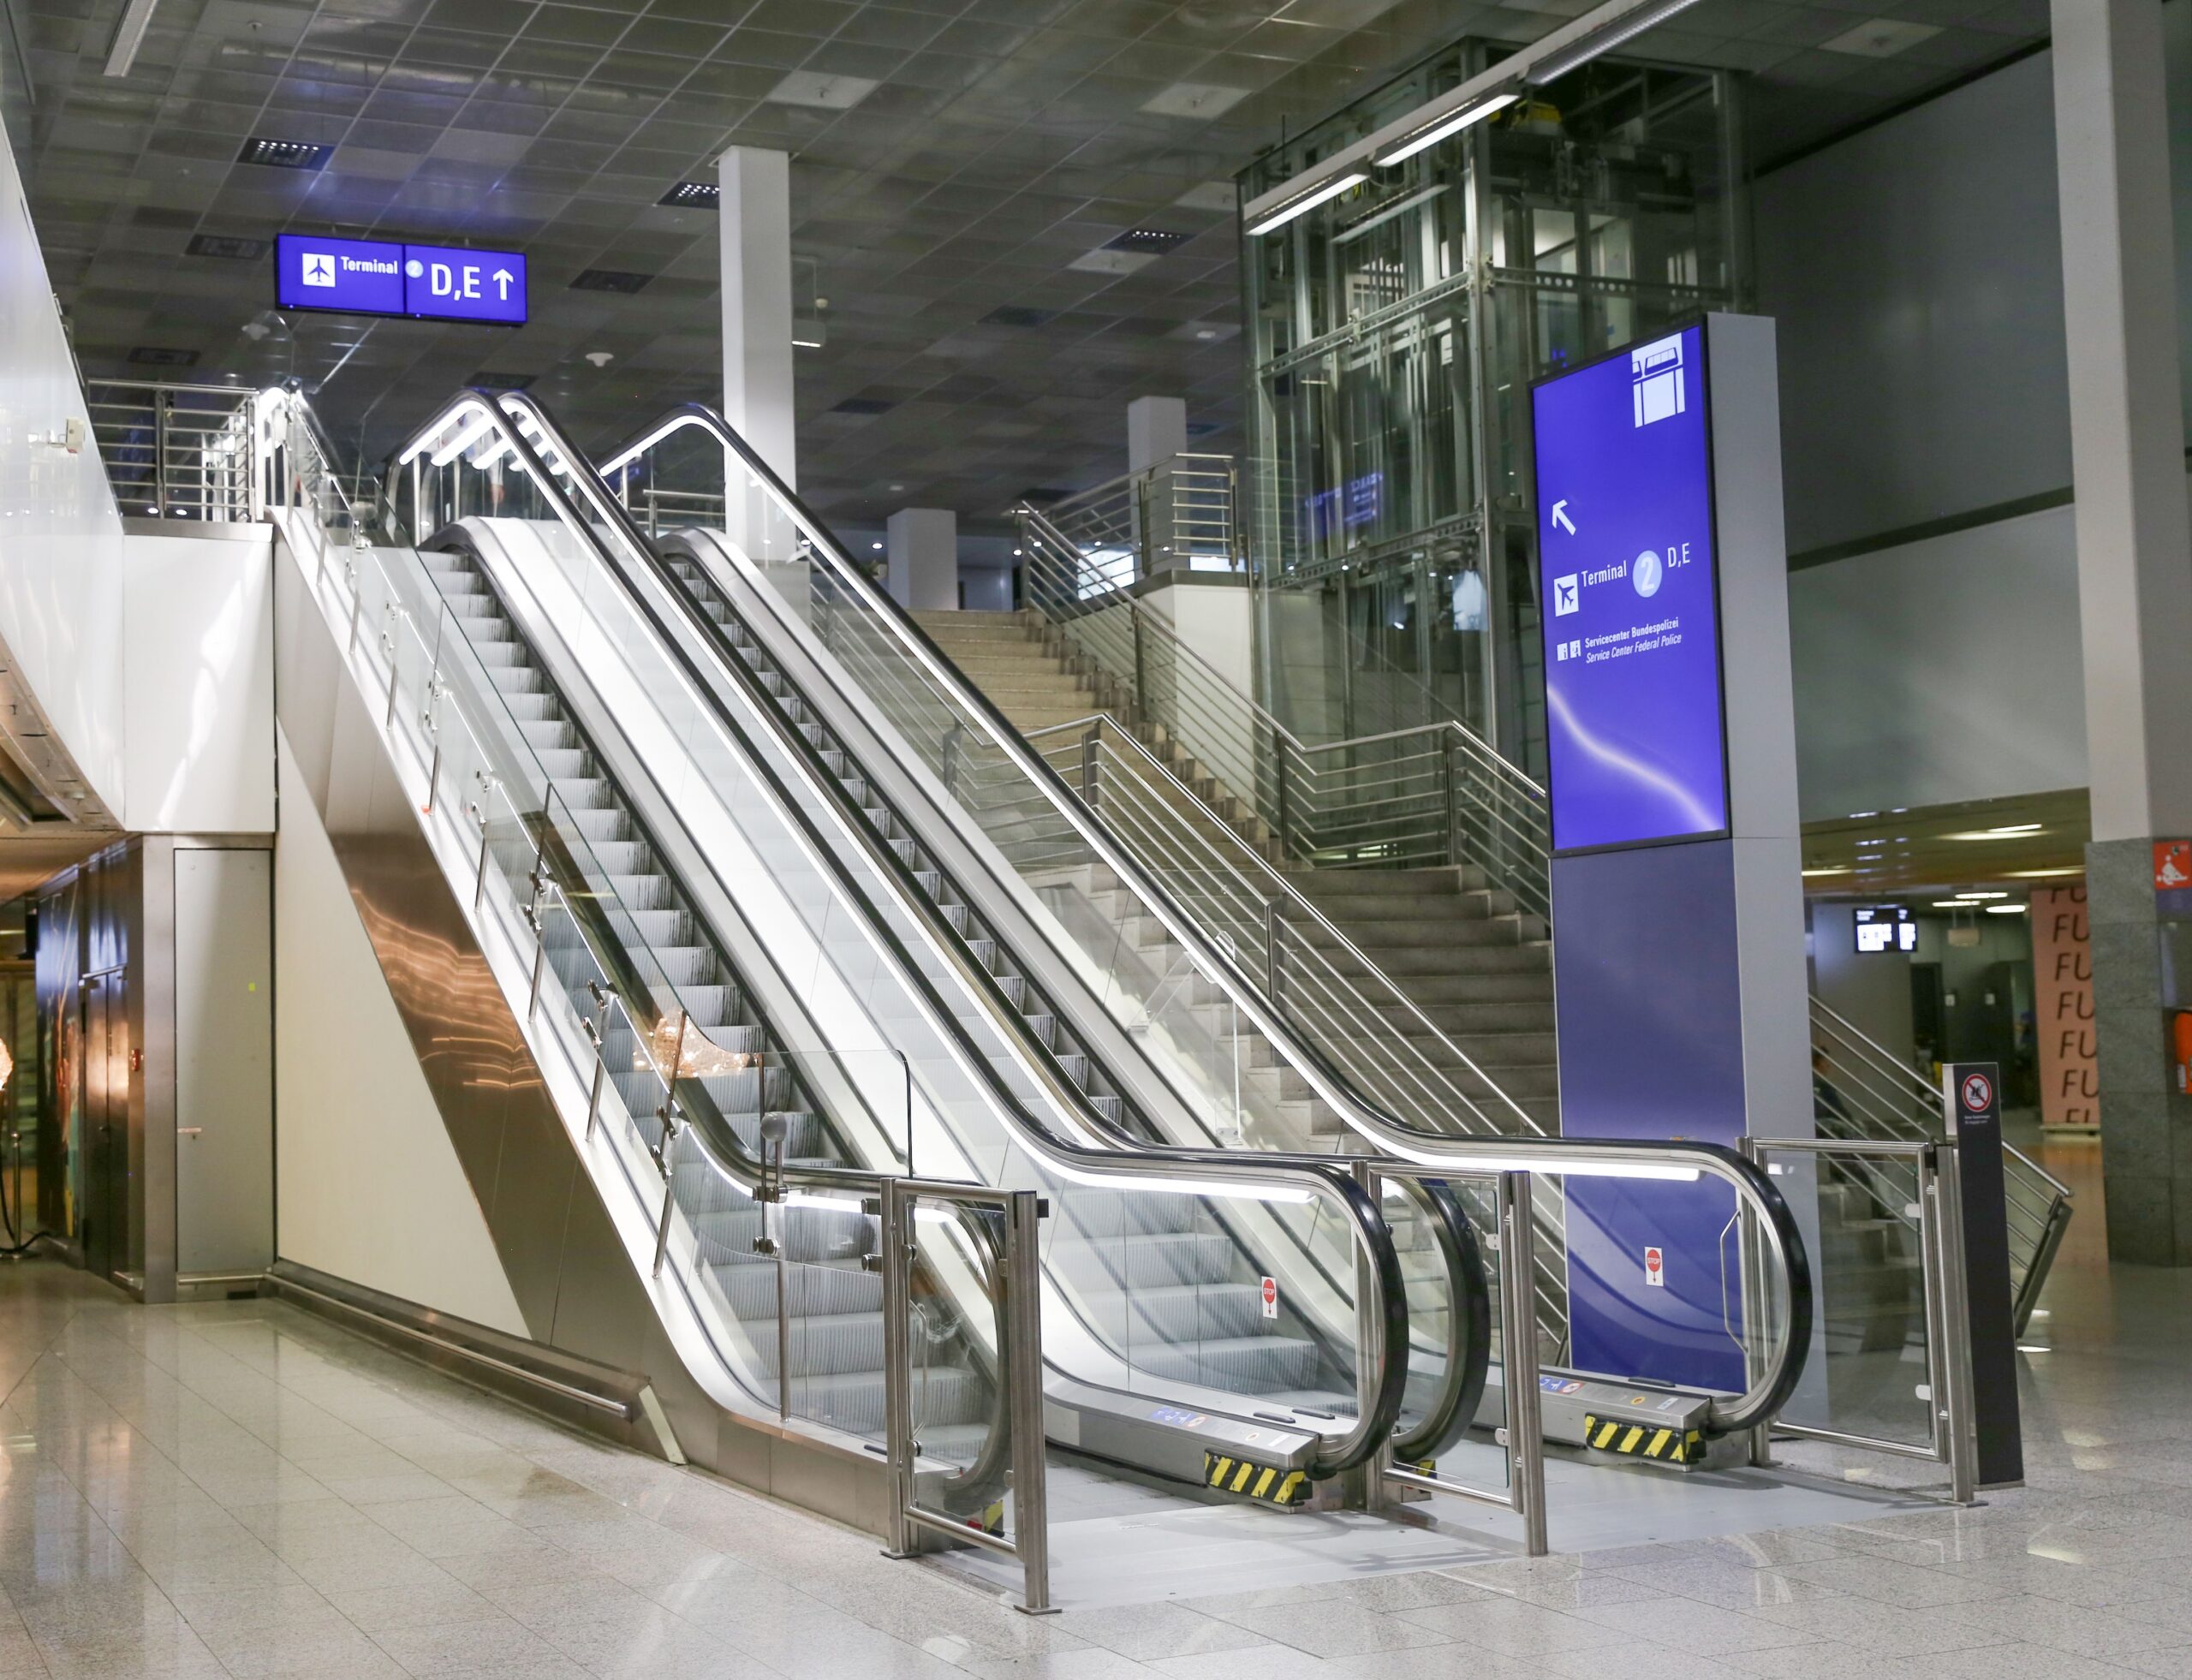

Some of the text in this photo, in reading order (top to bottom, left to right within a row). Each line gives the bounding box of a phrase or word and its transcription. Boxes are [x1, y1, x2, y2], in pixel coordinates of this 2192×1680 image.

[341, 256, 398, 275] Terminal
[431, 263, 481, 301] D,E
[1581, 542, 1690, 592] Terminal 2 D,E
[1585, 617, 1679, 648] Servicecenter Bundespolizei
[1586, 634, 1682, 664] Service Center Federal Police
